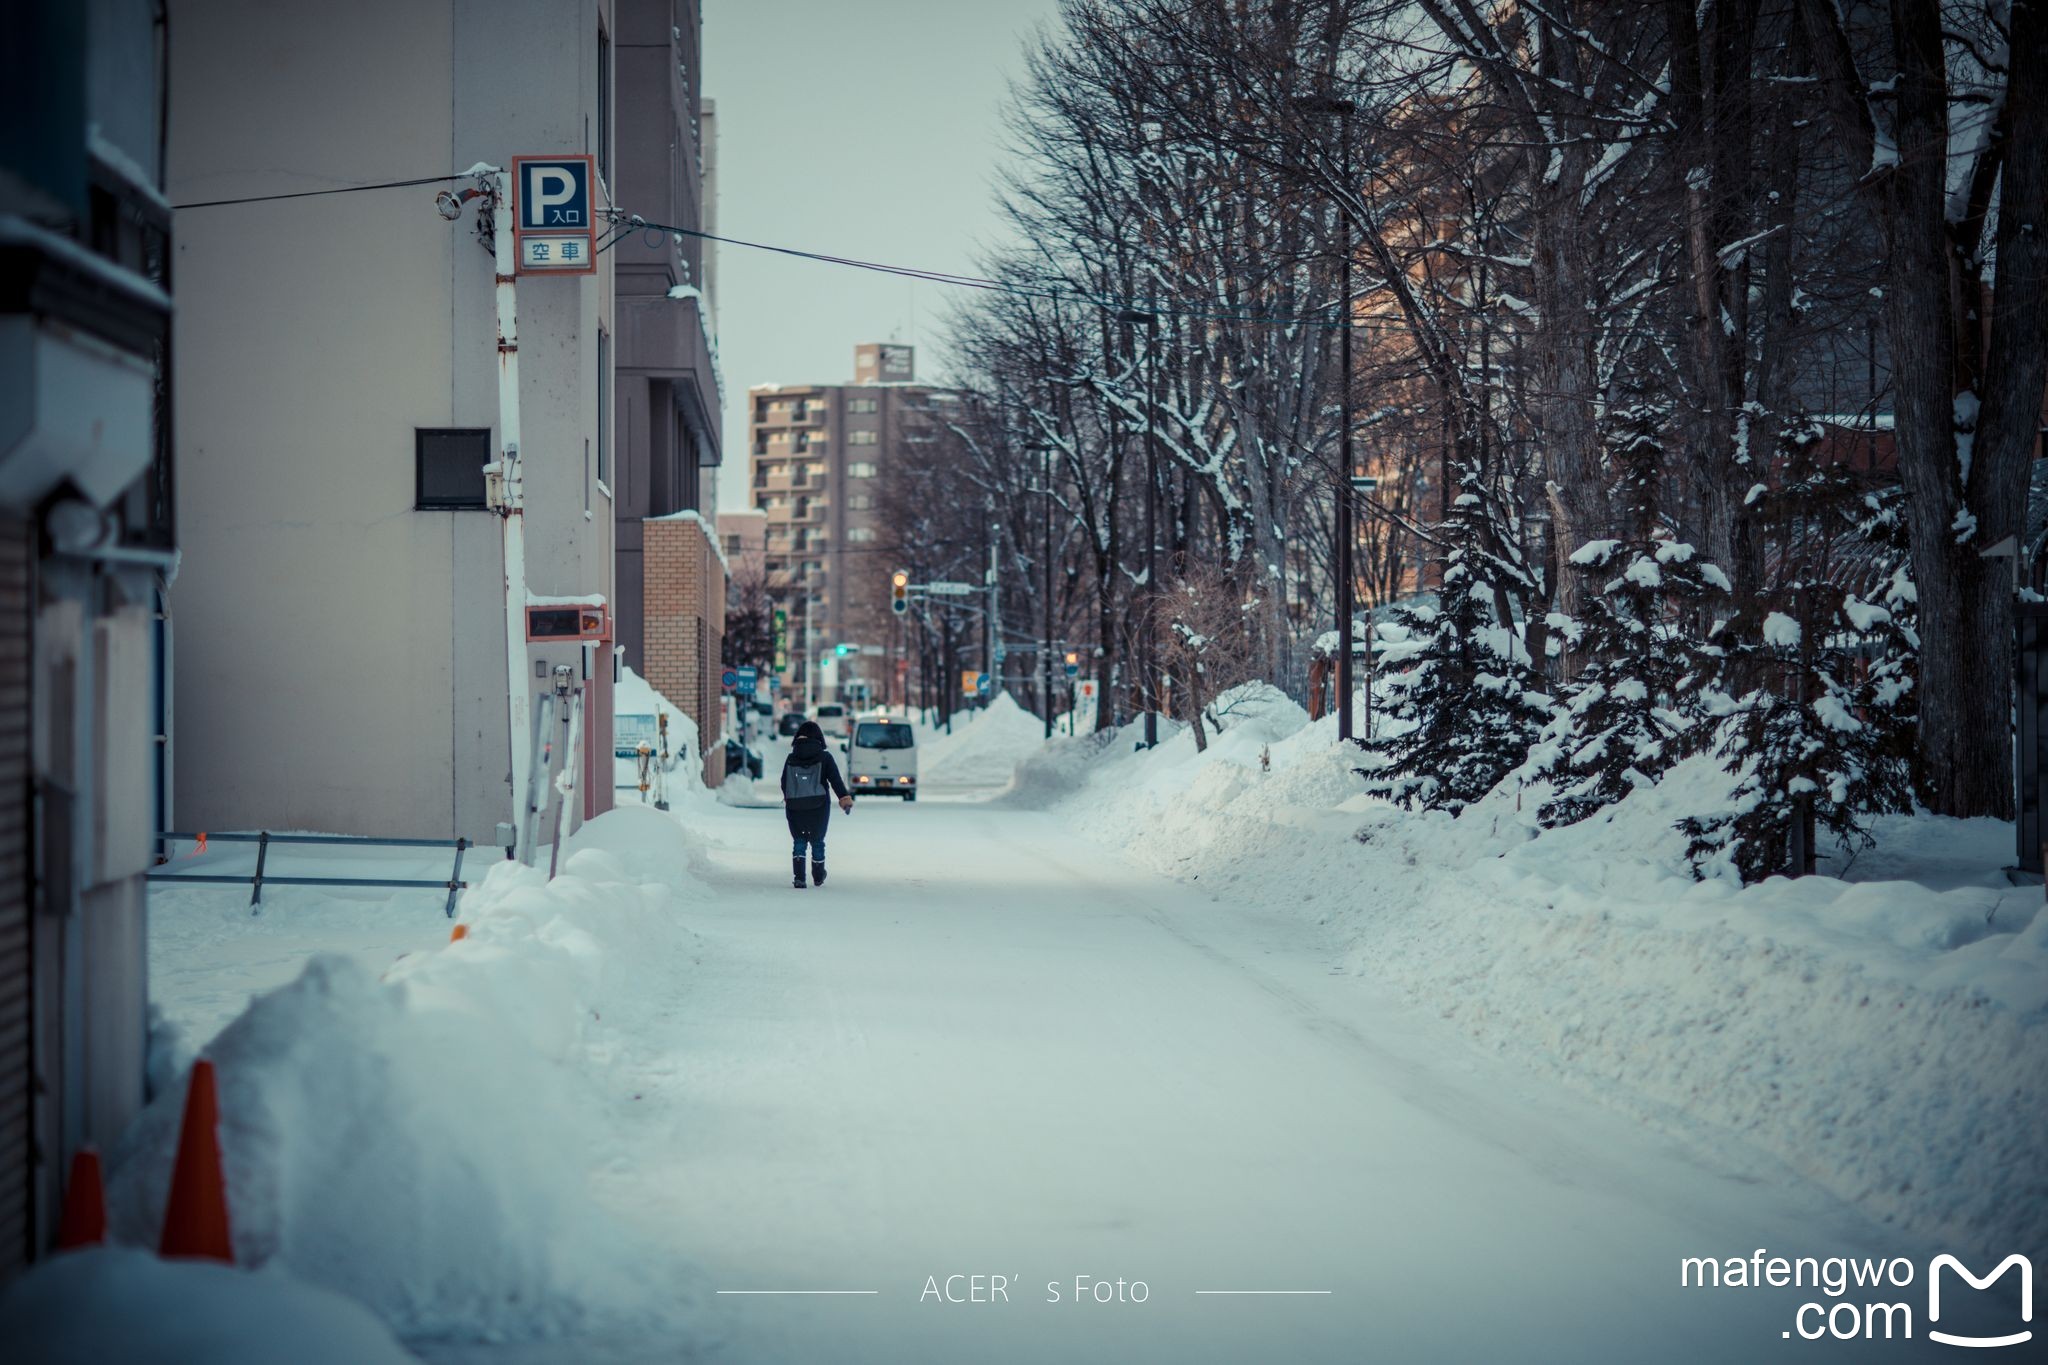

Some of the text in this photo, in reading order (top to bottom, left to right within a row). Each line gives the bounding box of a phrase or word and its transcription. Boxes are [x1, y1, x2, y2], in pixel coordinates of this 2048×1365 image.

[530, 167, 577, 225] P
[552, 209, 579, 224] 入口
[532, 241, 580, 261] 空車
